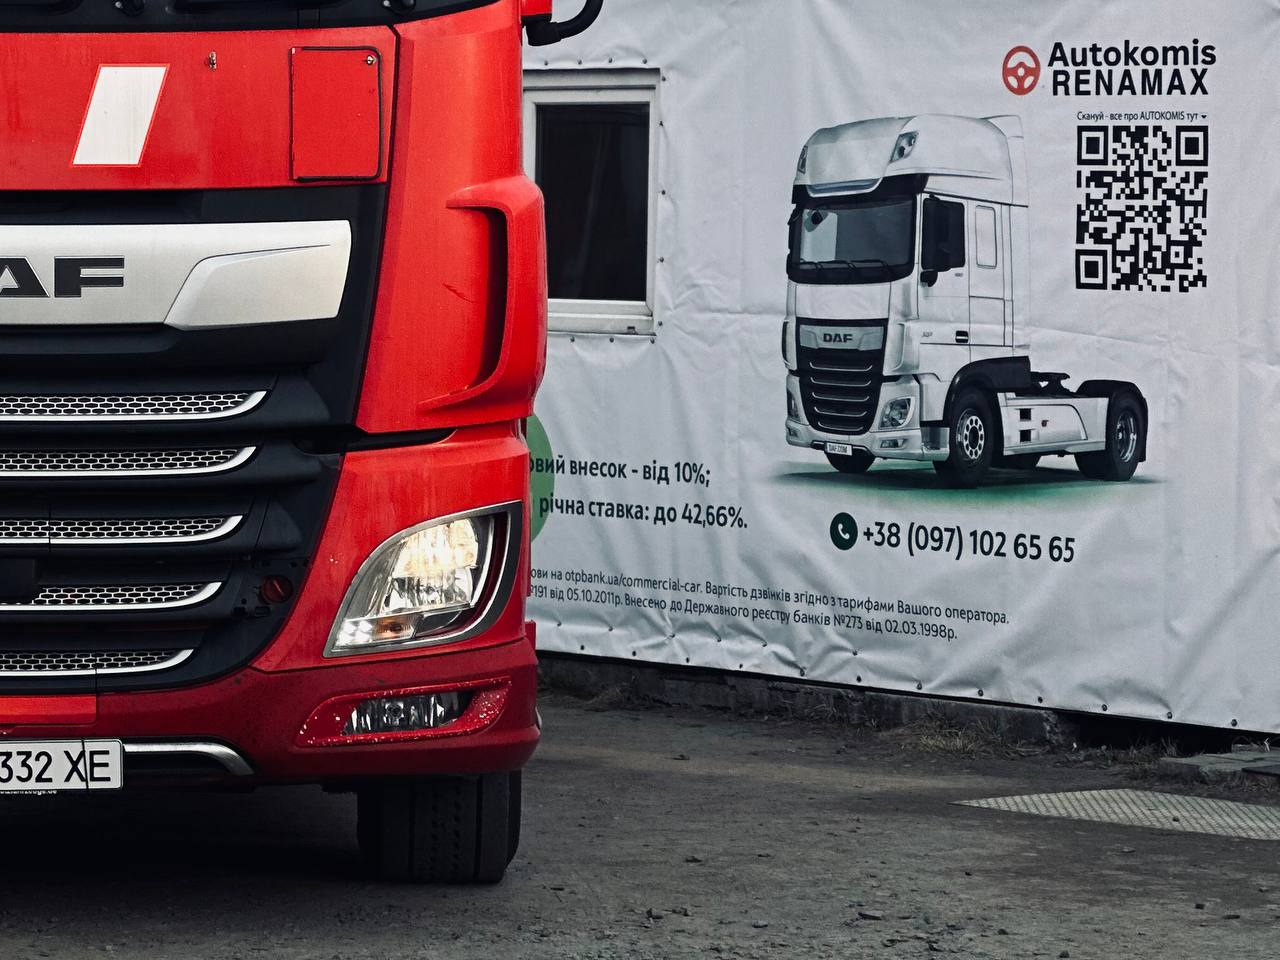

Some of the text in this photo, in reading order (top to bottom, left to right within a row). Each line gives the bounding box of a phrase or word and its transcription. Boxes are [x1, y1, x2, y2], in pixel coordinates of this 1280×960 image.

[1047, 38, 1217, 68] Autokomis
[1052, 68, 1209, 96] RENAMAX
[1076, 111, 1104, 122] Скануй
[1109, 113, 1122, 121] все
[1124, 113, 1138, 122] про
[1139, 110, 1185, 121] AUTOKOMIS
[1186, 112, 1199, 122] тут
[823, 333, 853, 343] DAF
[570, 460, 627, 479] внесок
[642, 459, 670, 485] від
[674, 461, 711, 487] 10%;
[539, 492, 748, 528] річна ставка: до 42,66%.
[863, 521, 1076, 563] +38 (097) 102 65 65
[551, 570, 562, 581] на
[564, 569, 703, 594] otpbank.ua/commercial-car.
[705, 581, 748, 598] Вартість
[750, 587, 791, 603] дзвінків
[793, 591, 829, 607] згідно
[830, 597, 836, 607] з
[837, 596, 894, 614] тарифами
[897, 600, 942, 617] Вашого
[945, 607, 1010, 625] оператора.
[550, 587, 564, 602] від
[566, 587, 623, 607] 05.10.2011р.
[624, 593, 667, 610] Внесено
[670, 599, 682, 613] до
[684, 598, 749, 618] Державного
[752, 607, 790, 625] реєстру
[793, 609, 831, 626] банків
[833, 613, 863, 630] №273
[865, 618, 883, 634] від
[884, 619, 958, 642] 02.03.1998р.
[64, 750, 111, 783] XE
